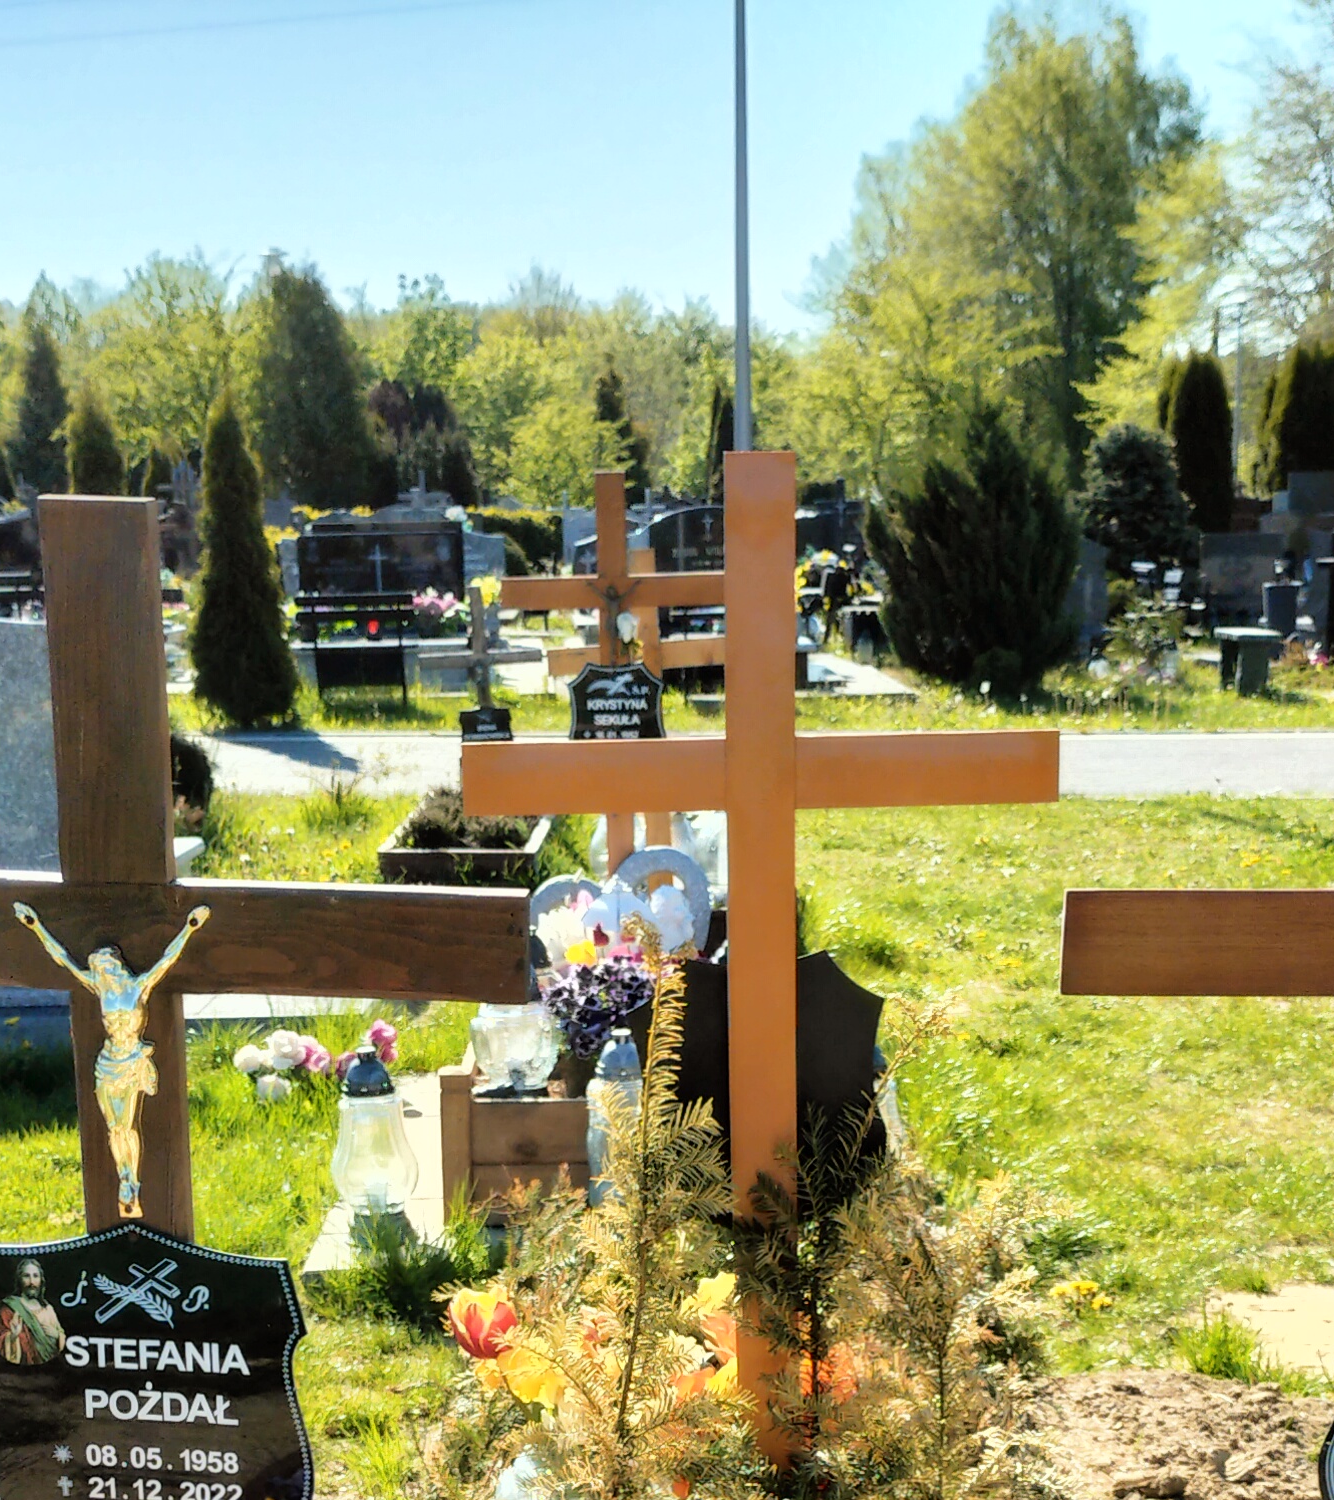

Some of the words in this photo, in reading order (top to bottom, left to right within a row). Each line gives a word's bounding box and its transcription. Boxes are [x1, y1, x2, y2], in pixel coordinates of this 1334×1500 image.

[587, 699, 649, 711] KRYSTYNA
[65, 1336, 250, 1376] STEFANIA
[84, 1381, 240, 1427] POŻDAŁ
